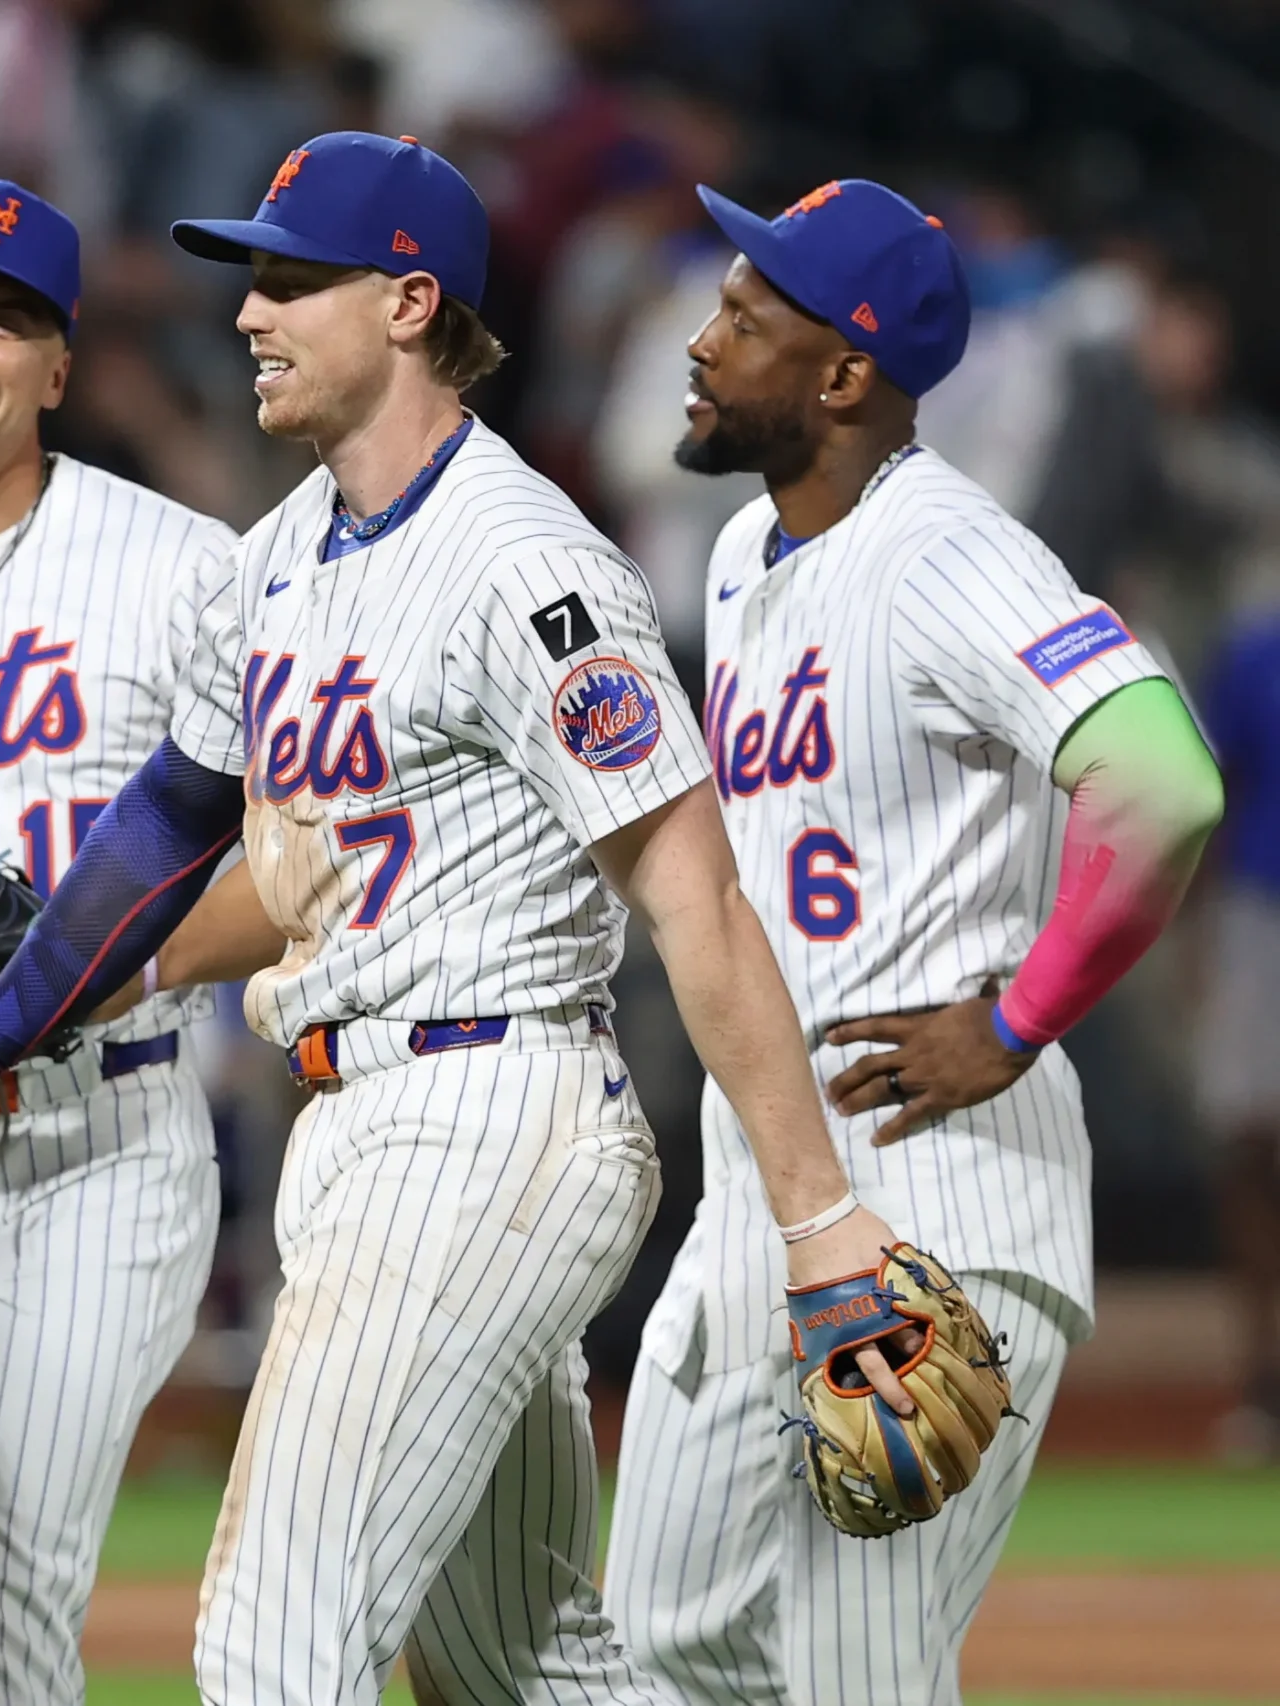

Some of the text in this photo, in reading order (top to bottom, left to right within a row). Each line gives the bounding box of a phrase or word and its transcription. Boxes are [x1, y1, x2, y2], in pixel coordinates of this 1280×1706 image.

[546, 604, 572, 650] 7
[582, 690, 645, 750] Mets
[333, 808, 416, 930] 7
[787, 828, 861, 942] 6
[803, 1294, 881, 1331] Wilson
